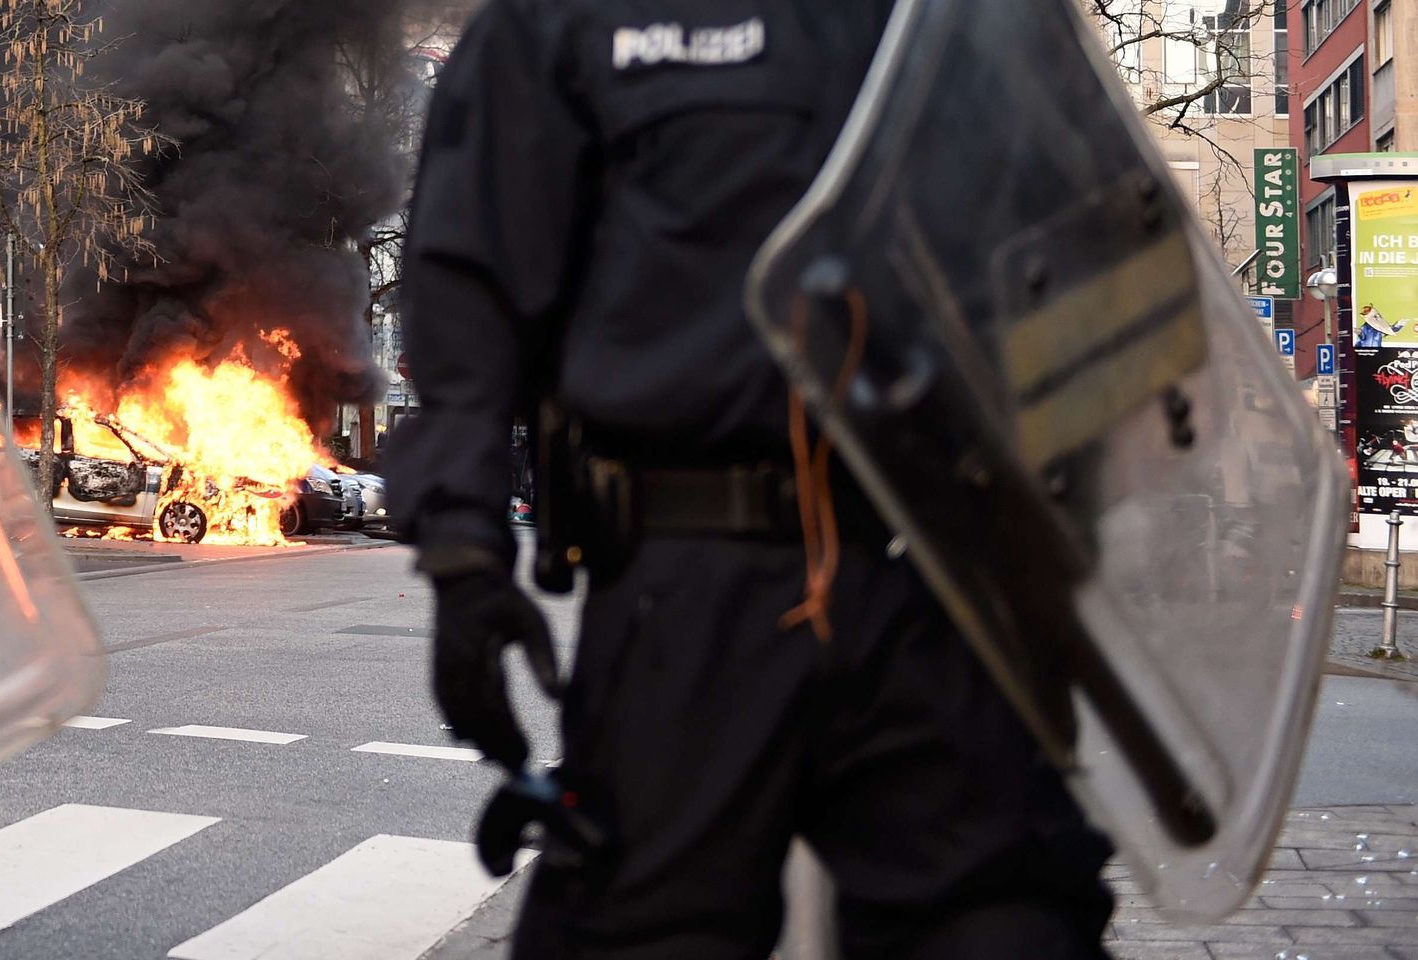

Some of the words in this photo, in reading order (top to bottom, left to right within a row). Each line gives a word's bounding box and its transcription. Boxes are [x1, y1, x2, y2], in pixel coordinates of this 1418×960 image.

[1260, 152, 1283, 217] STAR
[1373, 234, 1402, 248] ICH
[1262, 224, 1285, 295] FOUR
[1359, 251, 1374, 264] IN
[1378, 251, 1406, 264] DIE
[1278, 333, 1290, 352] P
[1320, 348, 1330, 371] P
[1357, 485, 1378, 497] ALTE
[1378, 486, 1407, 498] OPER
